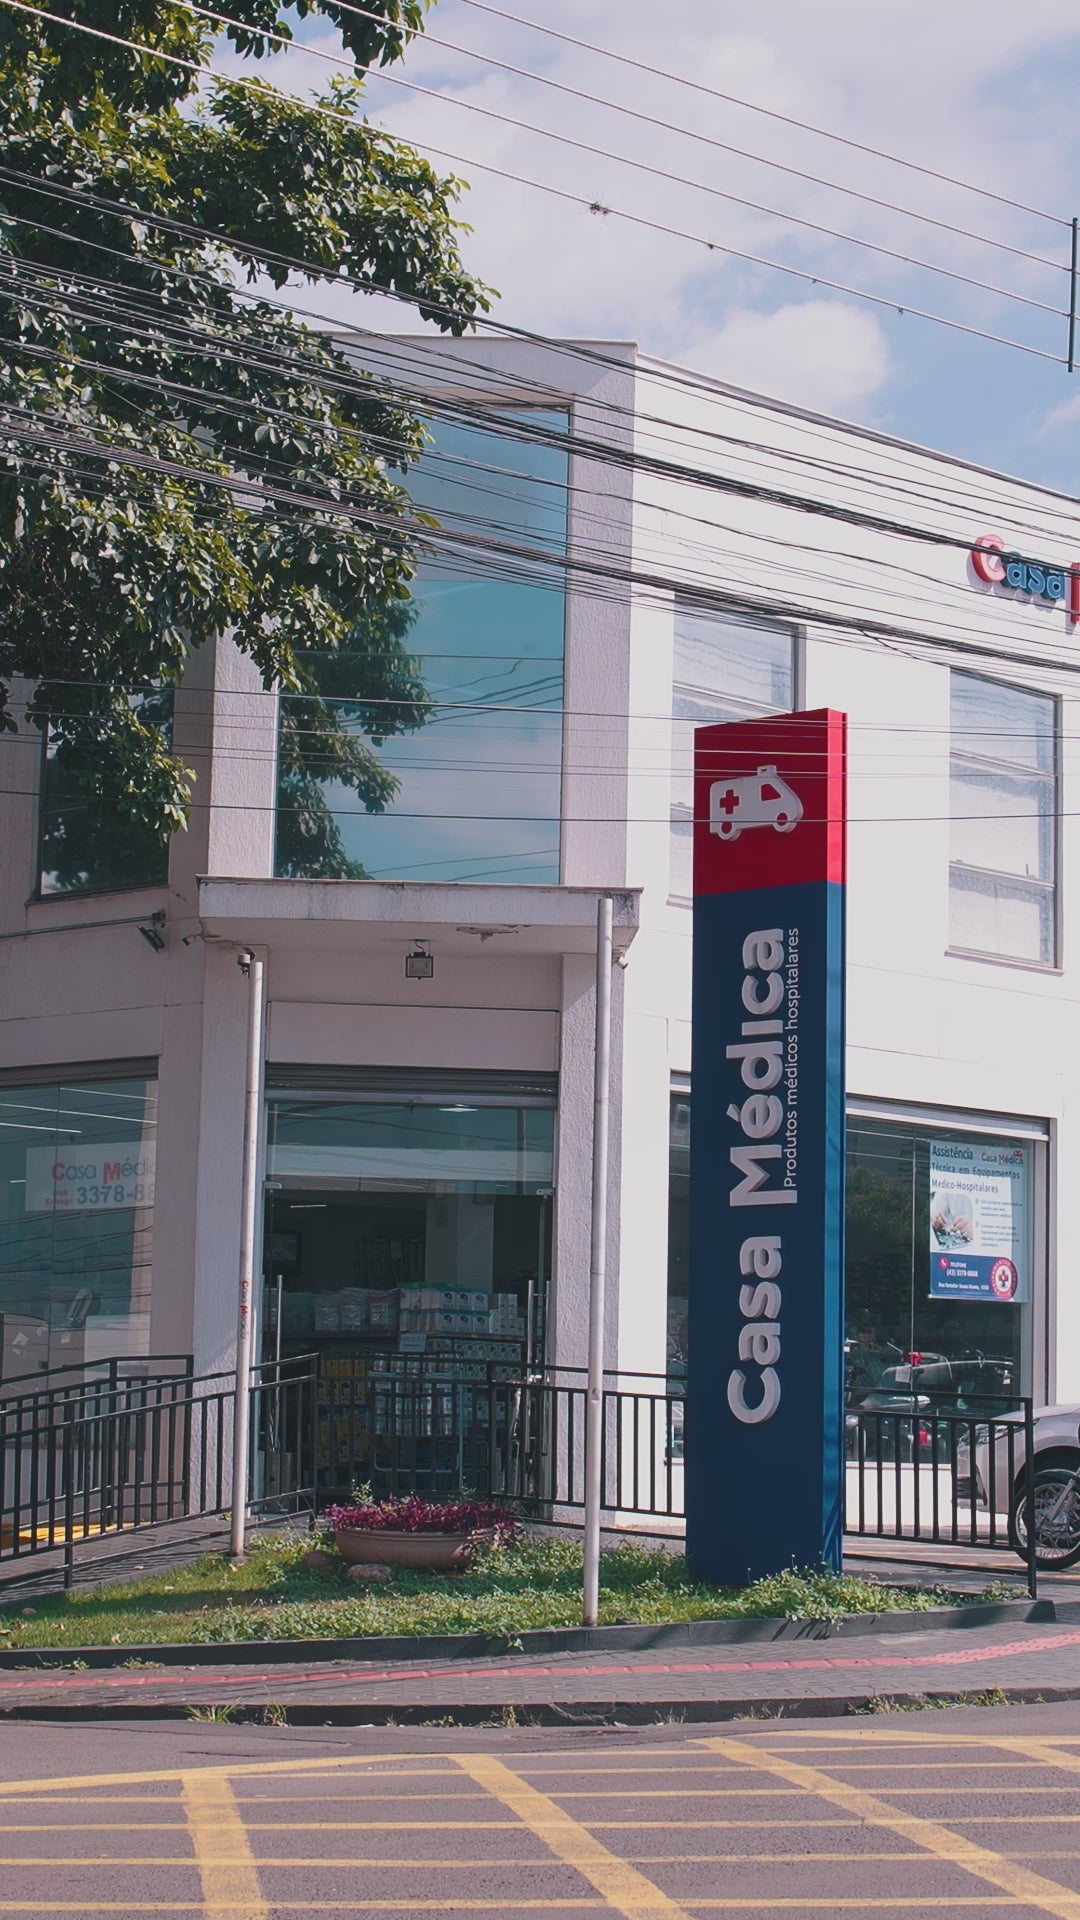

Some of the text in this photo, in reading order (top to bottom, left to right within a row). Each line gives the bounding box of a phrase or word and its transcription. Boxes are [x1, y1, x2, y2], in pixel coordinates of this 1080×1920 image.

[971, 534, 1065, 600] Casa
[784, 928, 801, 1187] Produtos médicos hospitalares
[931, 1145, 974, 1161] Assistência
[981, 1152, 998, 1164] Casa
[52, 1162, 97, 1181] Casa
[726, 928, 797, 1424] Casa Médica
[931, 1162, 1021, 1181] Técnica em Equipamentos
